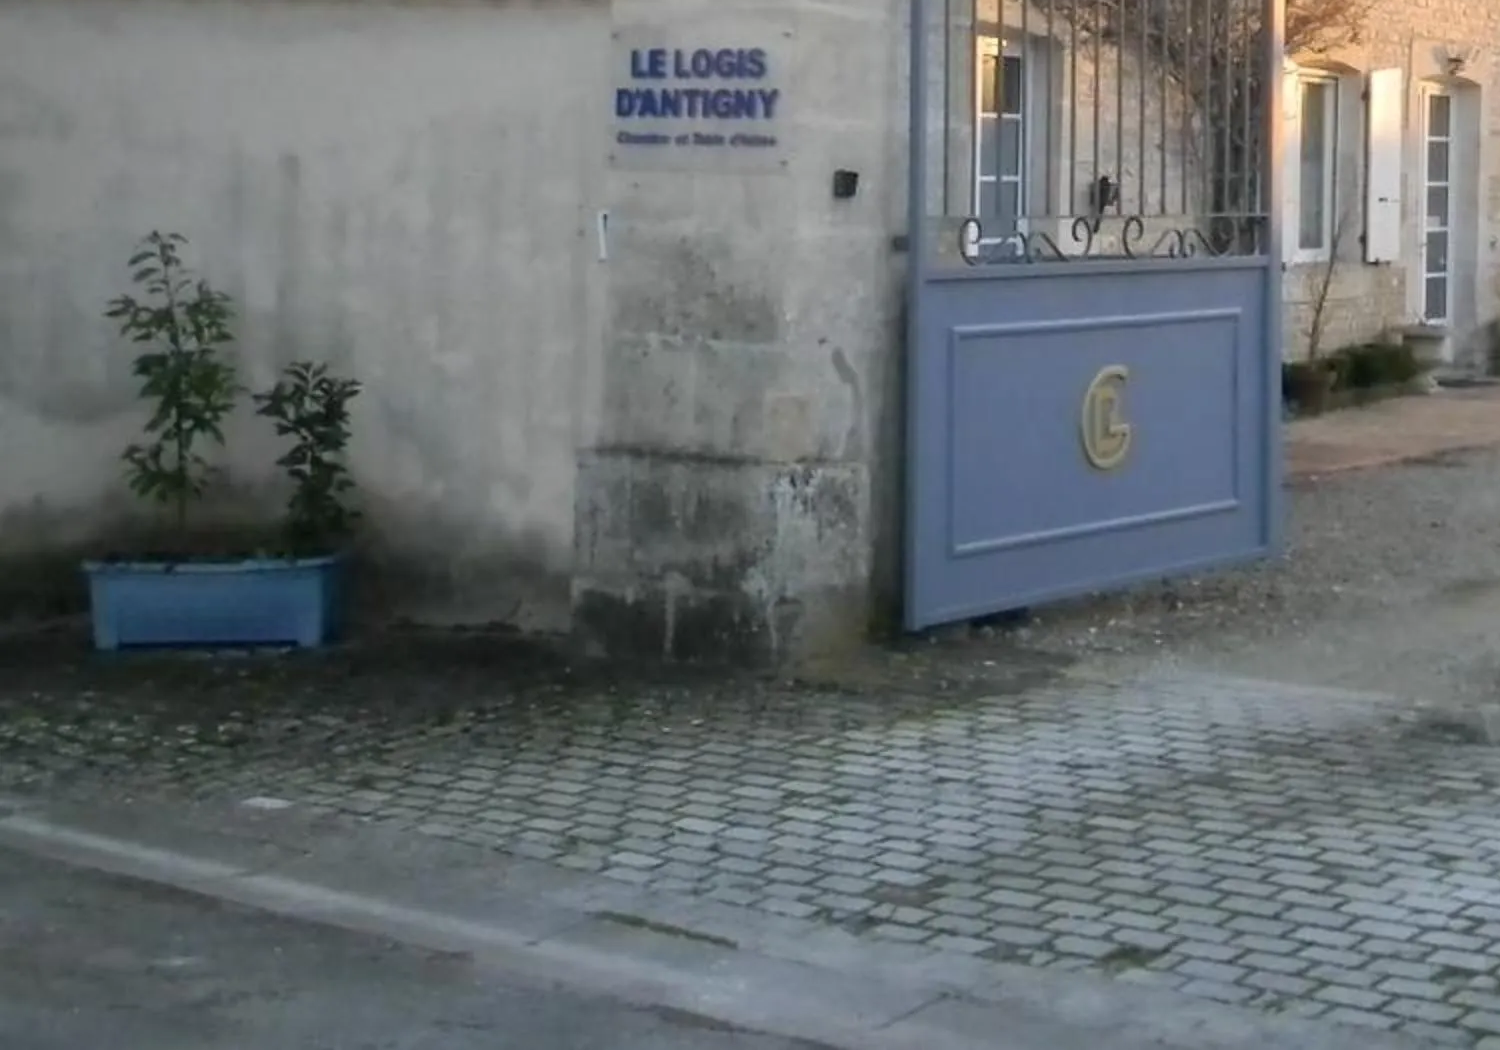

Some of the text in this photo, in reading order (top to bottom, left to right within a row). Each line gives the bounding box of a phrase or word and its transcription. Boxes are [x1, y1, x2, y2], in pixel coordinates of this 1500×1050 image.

[631, 47, 767, 79] LE LOGIS
[615, 87, 780, 119] D'ANTIGNY
